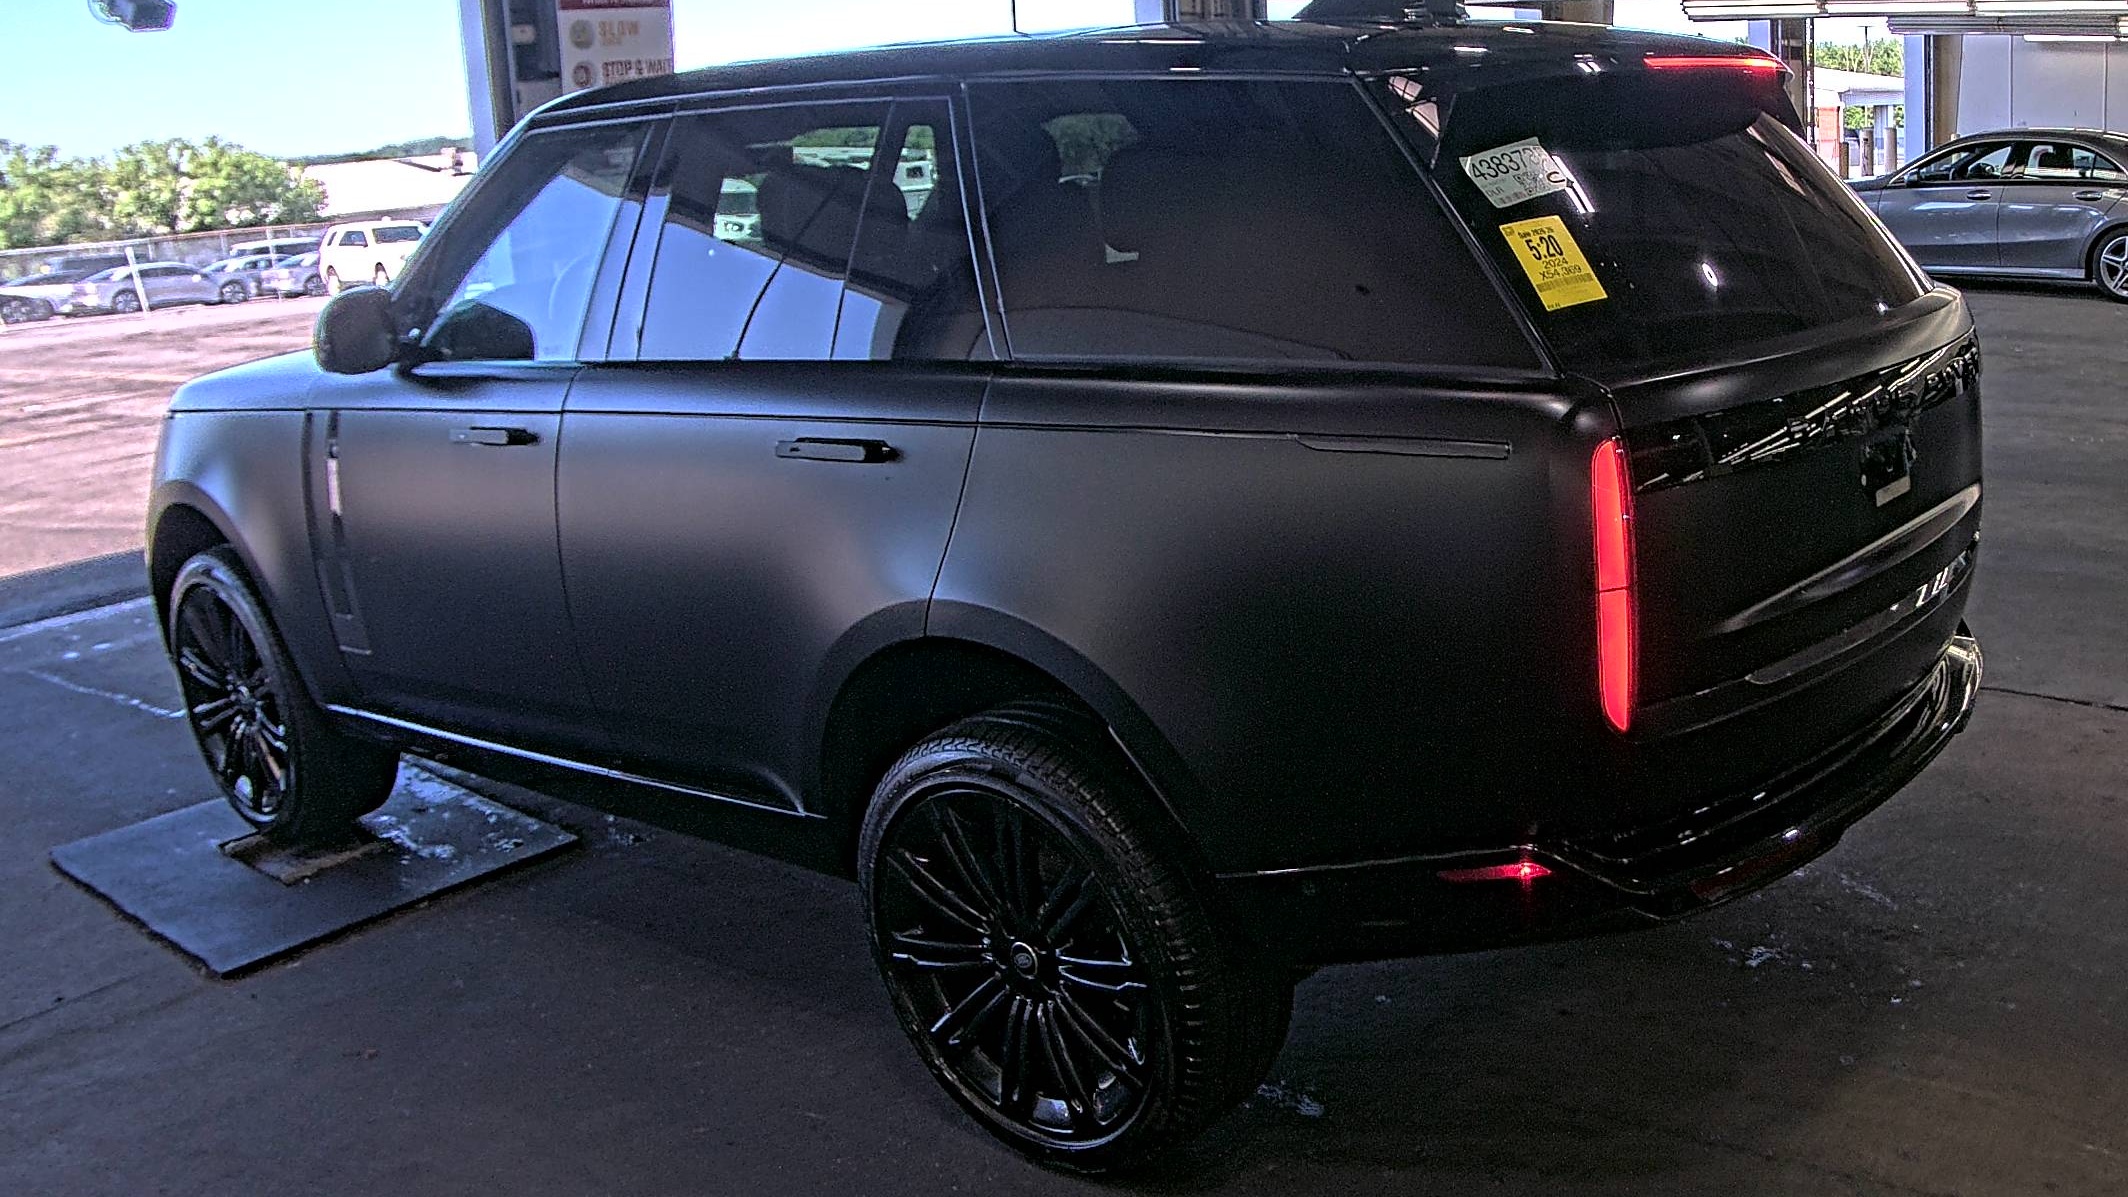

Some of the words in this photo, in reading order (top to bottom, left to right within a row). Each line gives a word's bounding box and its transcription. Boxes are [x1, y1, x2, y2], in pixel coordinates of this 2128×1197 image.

[598, 21, 639, 36] SLOW
[602, 61, 632, 77] STOP
[646, 59, 671, 74] WAIT
[1542, 257, 1569, 270] 2024
